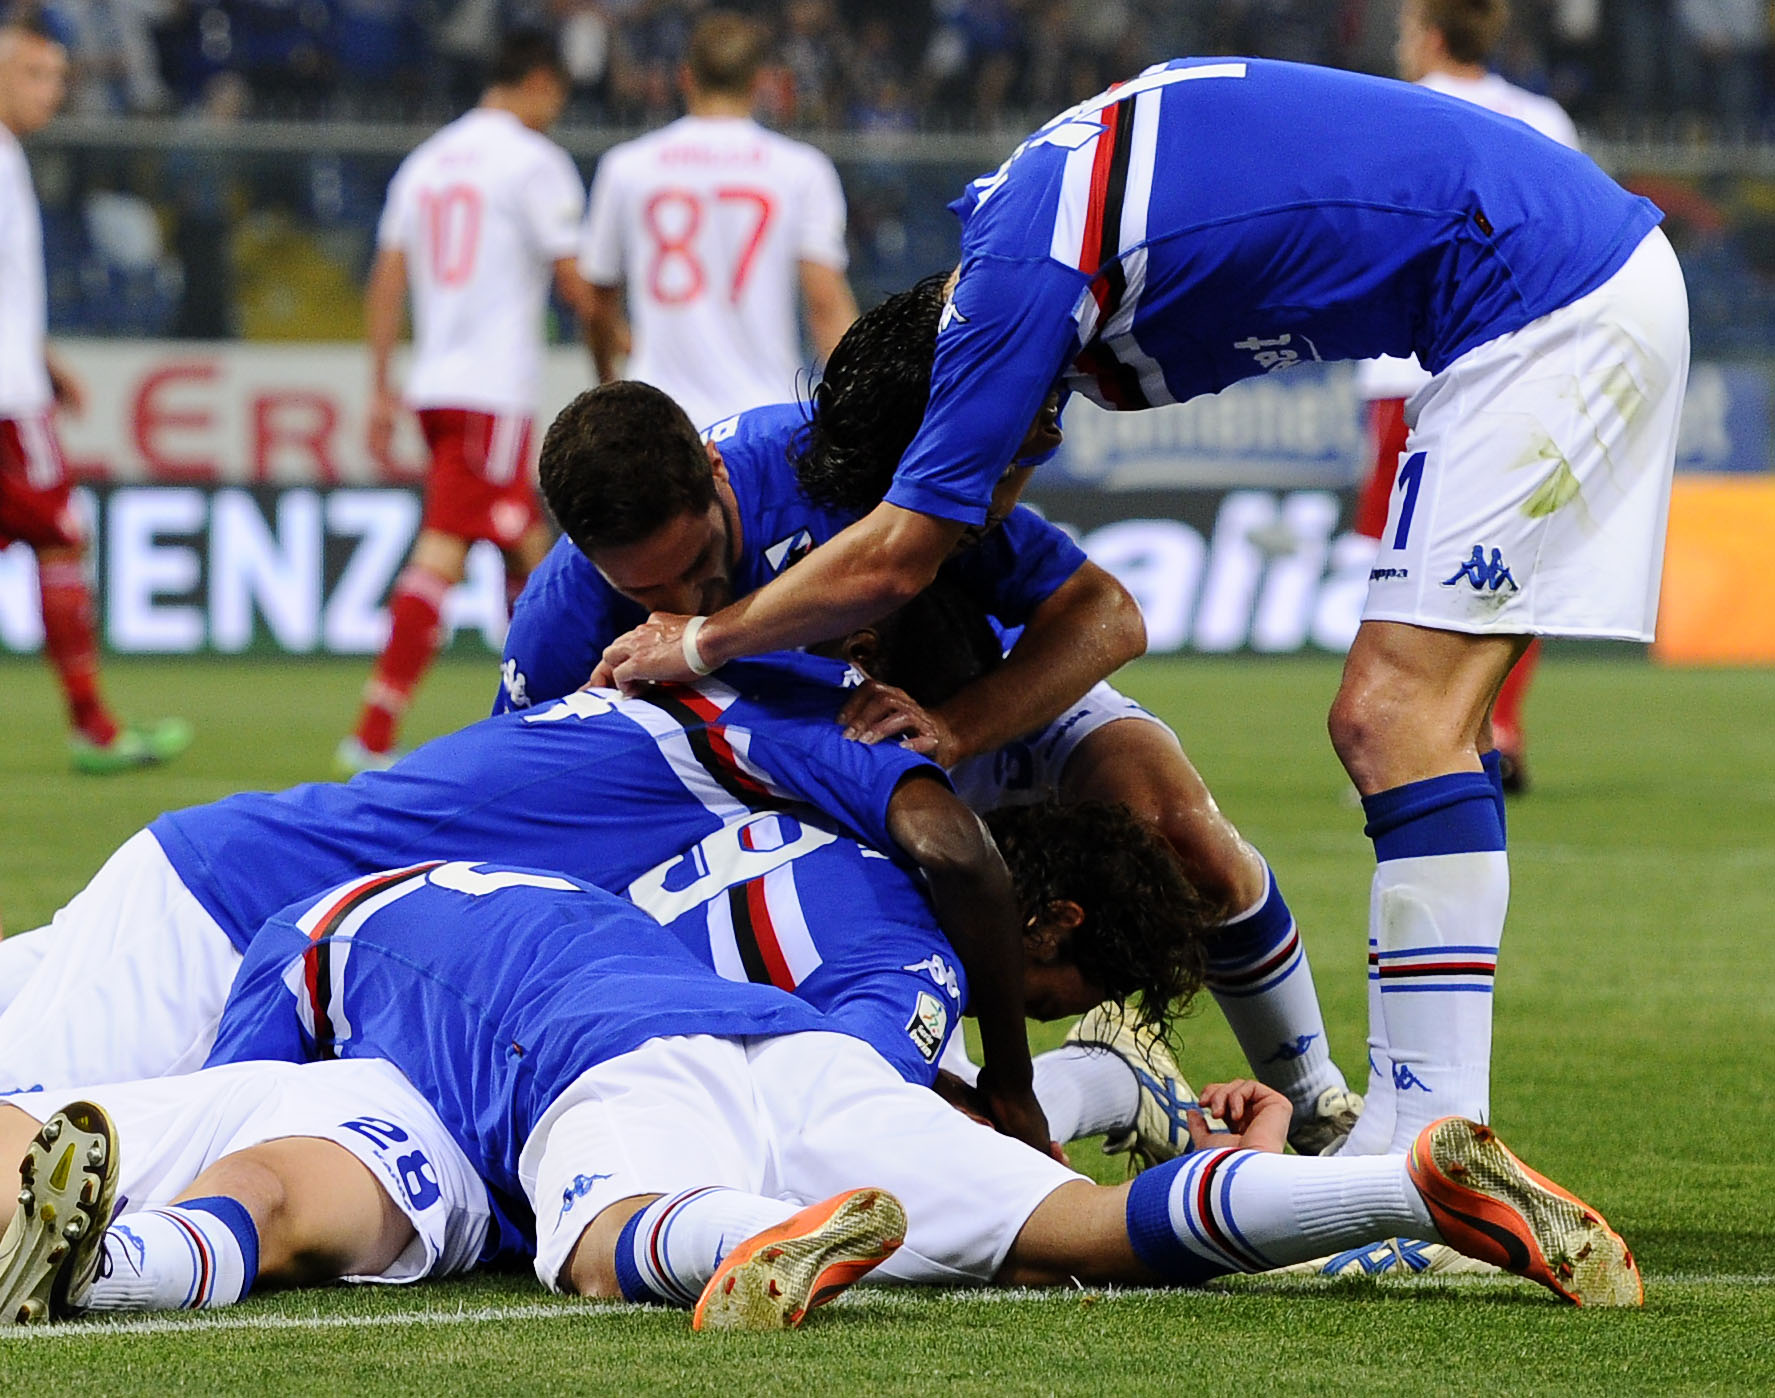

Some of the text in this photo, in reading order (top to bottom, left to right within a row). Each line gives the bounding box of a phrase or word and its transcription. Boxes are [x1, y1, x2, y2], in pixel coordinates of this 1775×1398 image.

[416, 184, 483, 290] 10
[644, 187, 772, 304] 87
[1052, 488, 1372, 655] alia
[337, 1116, 443, 1211] 28
